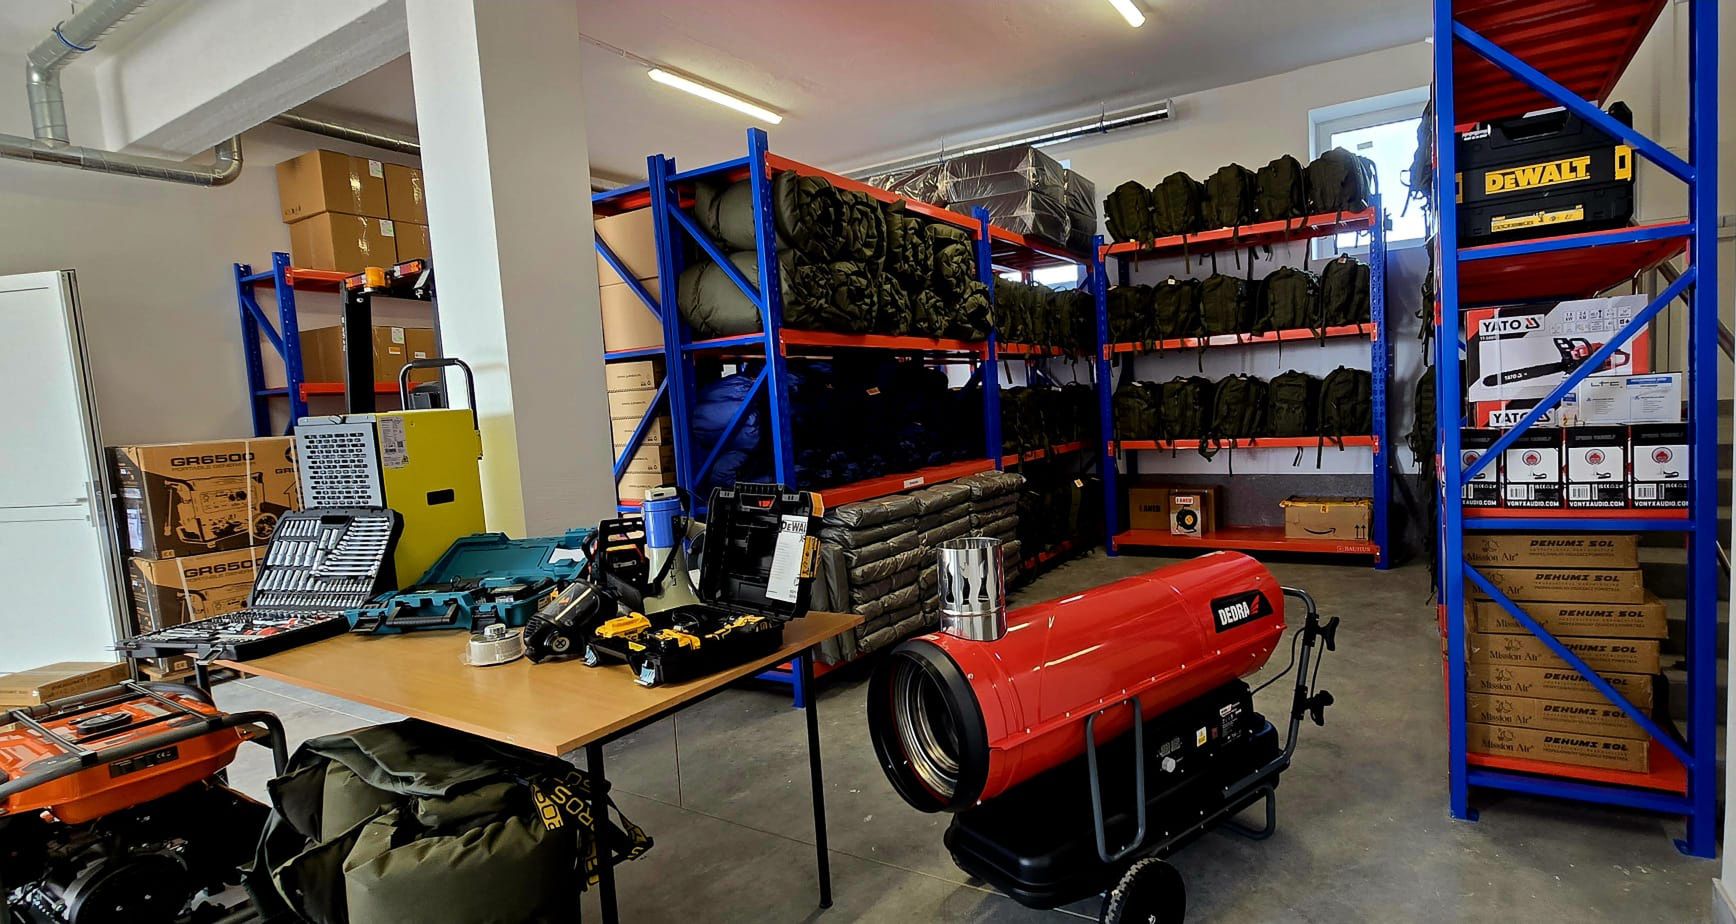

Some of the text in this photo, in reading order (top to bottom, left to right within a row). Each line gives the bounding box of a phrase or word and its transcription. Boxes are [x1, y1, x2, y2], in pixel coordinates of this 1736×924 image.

[1482, 320, 1521, 333] YATO
[171, 453, 254, 467] GR6500
[1530, 539, 1585, 547] DEHUMI
[1535, 573, 1590, 581] DEHUMI
[1593, 574, 1620, 582] SOL
[1218, 601, 1251, 626] DEDRA
[1559, 609, 1614, 617] DEHUMI
[1618, 610, 1645, 618] SOL
[1490, 650, 1521, 662] Mission
[1481, 679, 1512, 692] Mission
[1481, 711, 1512, 723] Mission
[1544, 704, 1598, 716] DEHUMI
[1544, 736, 1598, 748] DEHUMI
[1602, 742, 1629, 752] SOL
